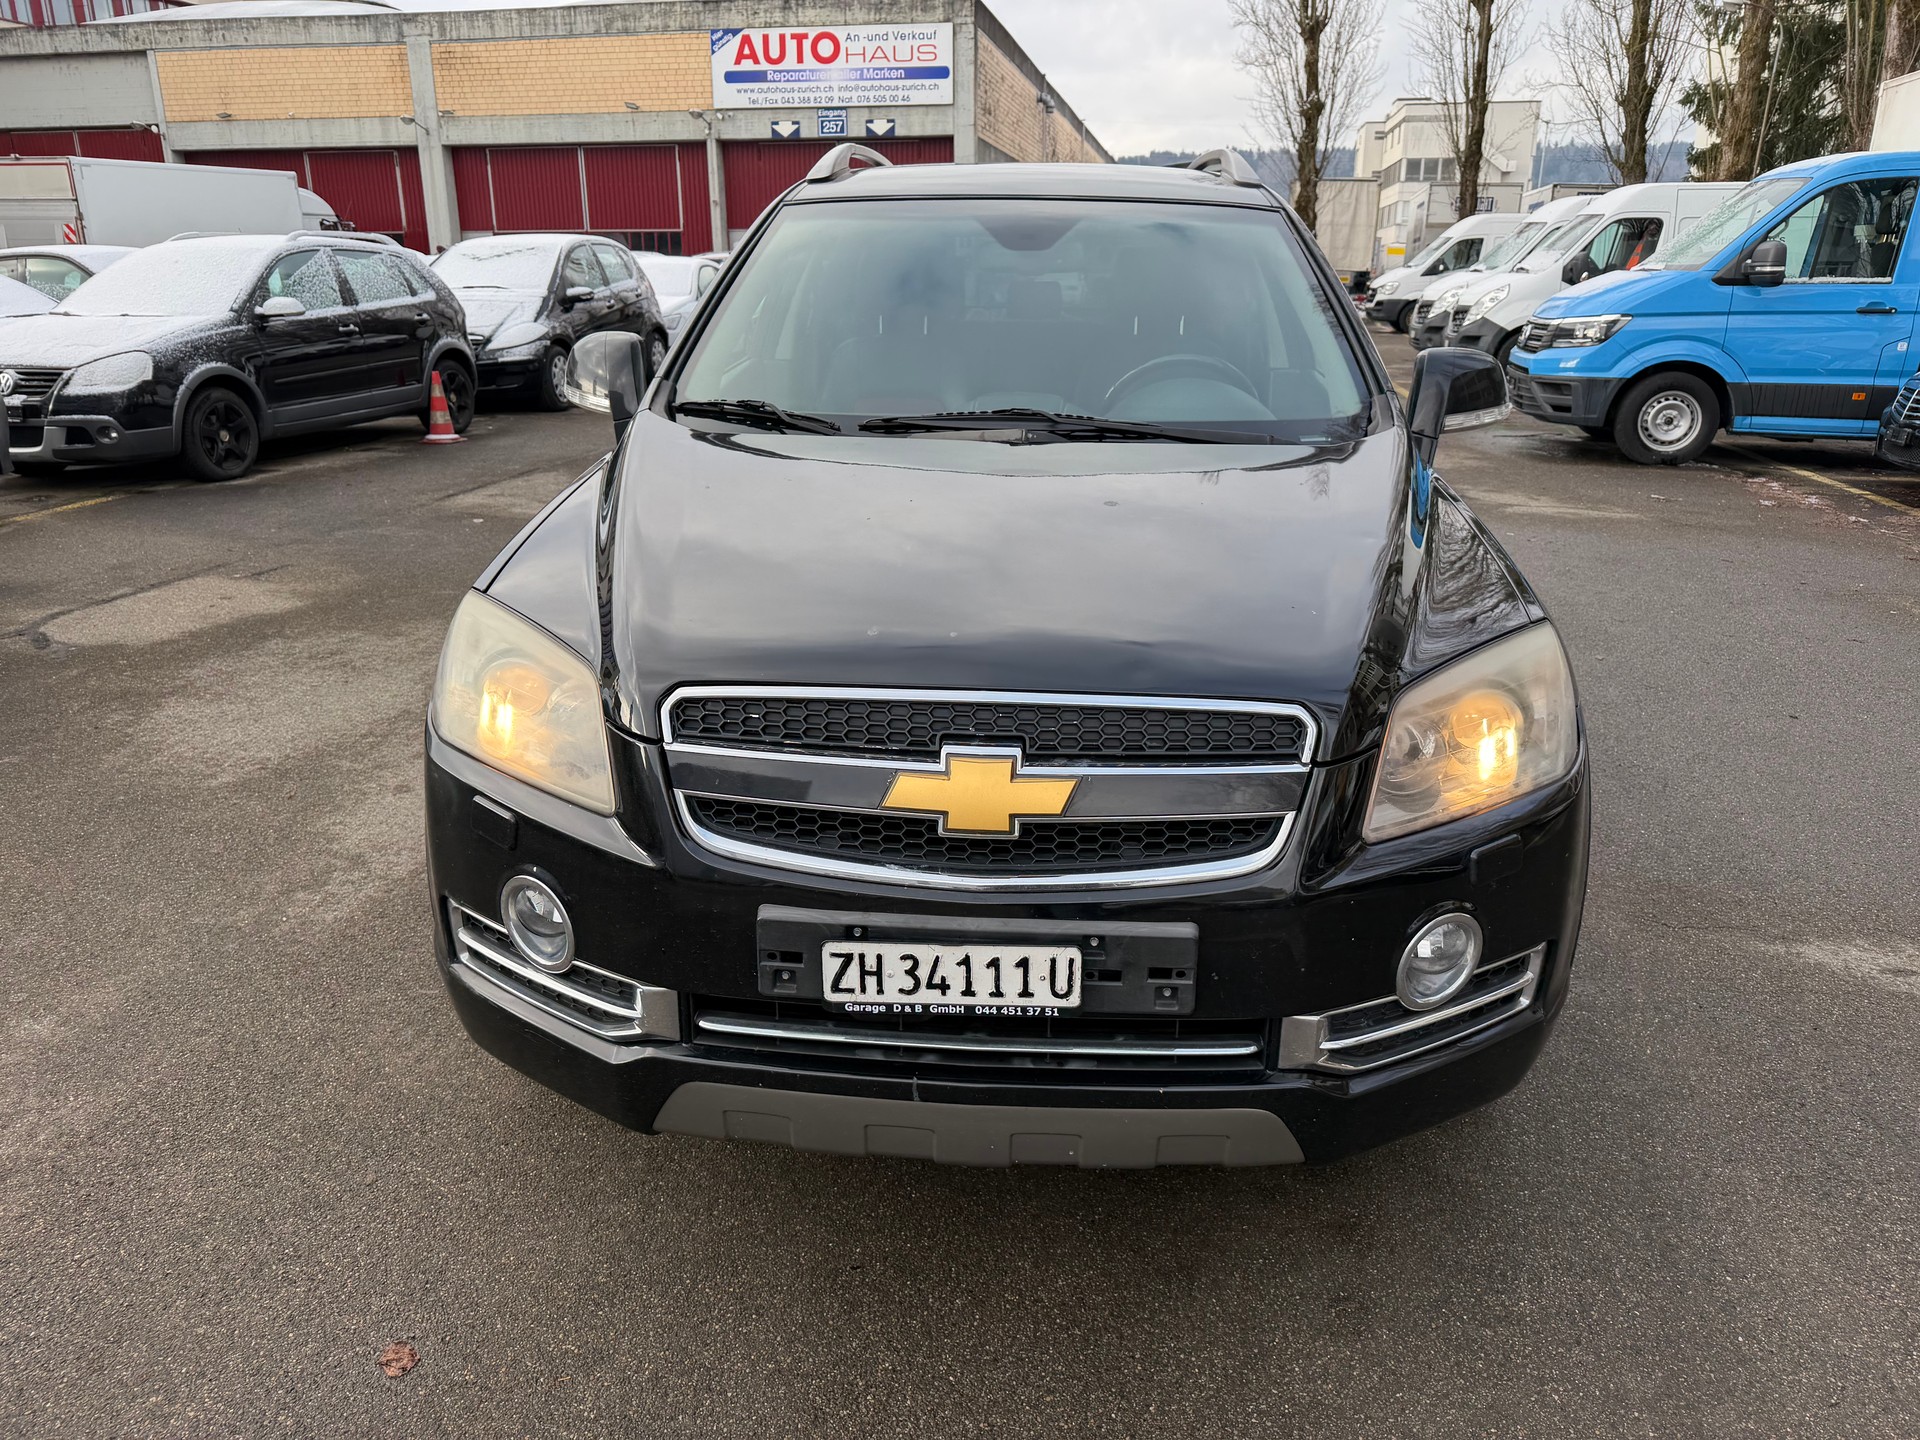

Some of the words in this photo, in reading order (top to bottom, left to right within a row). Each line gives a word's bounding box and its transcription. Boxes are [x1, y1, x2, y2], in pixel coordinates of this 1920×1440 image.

[845, 33, 859, 42] An
[863, 31, 889, 41] -und
[892, 30, 937, 41] Verkauf
[733, 31, 840, 66] AUTO
[845, 44, 937, 63] HAUS
[863, 68, 905, 79] Marken
[781, 96, 795, 104] 043
[824, 95, 835, 104] 09
[857, 95, 871, 103] 076
[873, 95, 887, 103] 505
[889, 94, 899, 102] 00
[818, 109, 847, 117] Eingang
[823, 121, 843, 132] 257
[829, 952, 884, 995] ZH
[845, 1003, 886, 1013] Garage
[893, 1004, 901, 1012] D
[904, 1005, 912, 1013] &
[915, 1005, 923, 1013] B
[929, 1005, 965, 1014] GmbH
[975, 1006, 997, 1015] 044
[1001, 1006, 1022, 1015] 451
[1026, 1007, 1041, 1016] 37
[1045, 1008, 1059, 1016] 51
